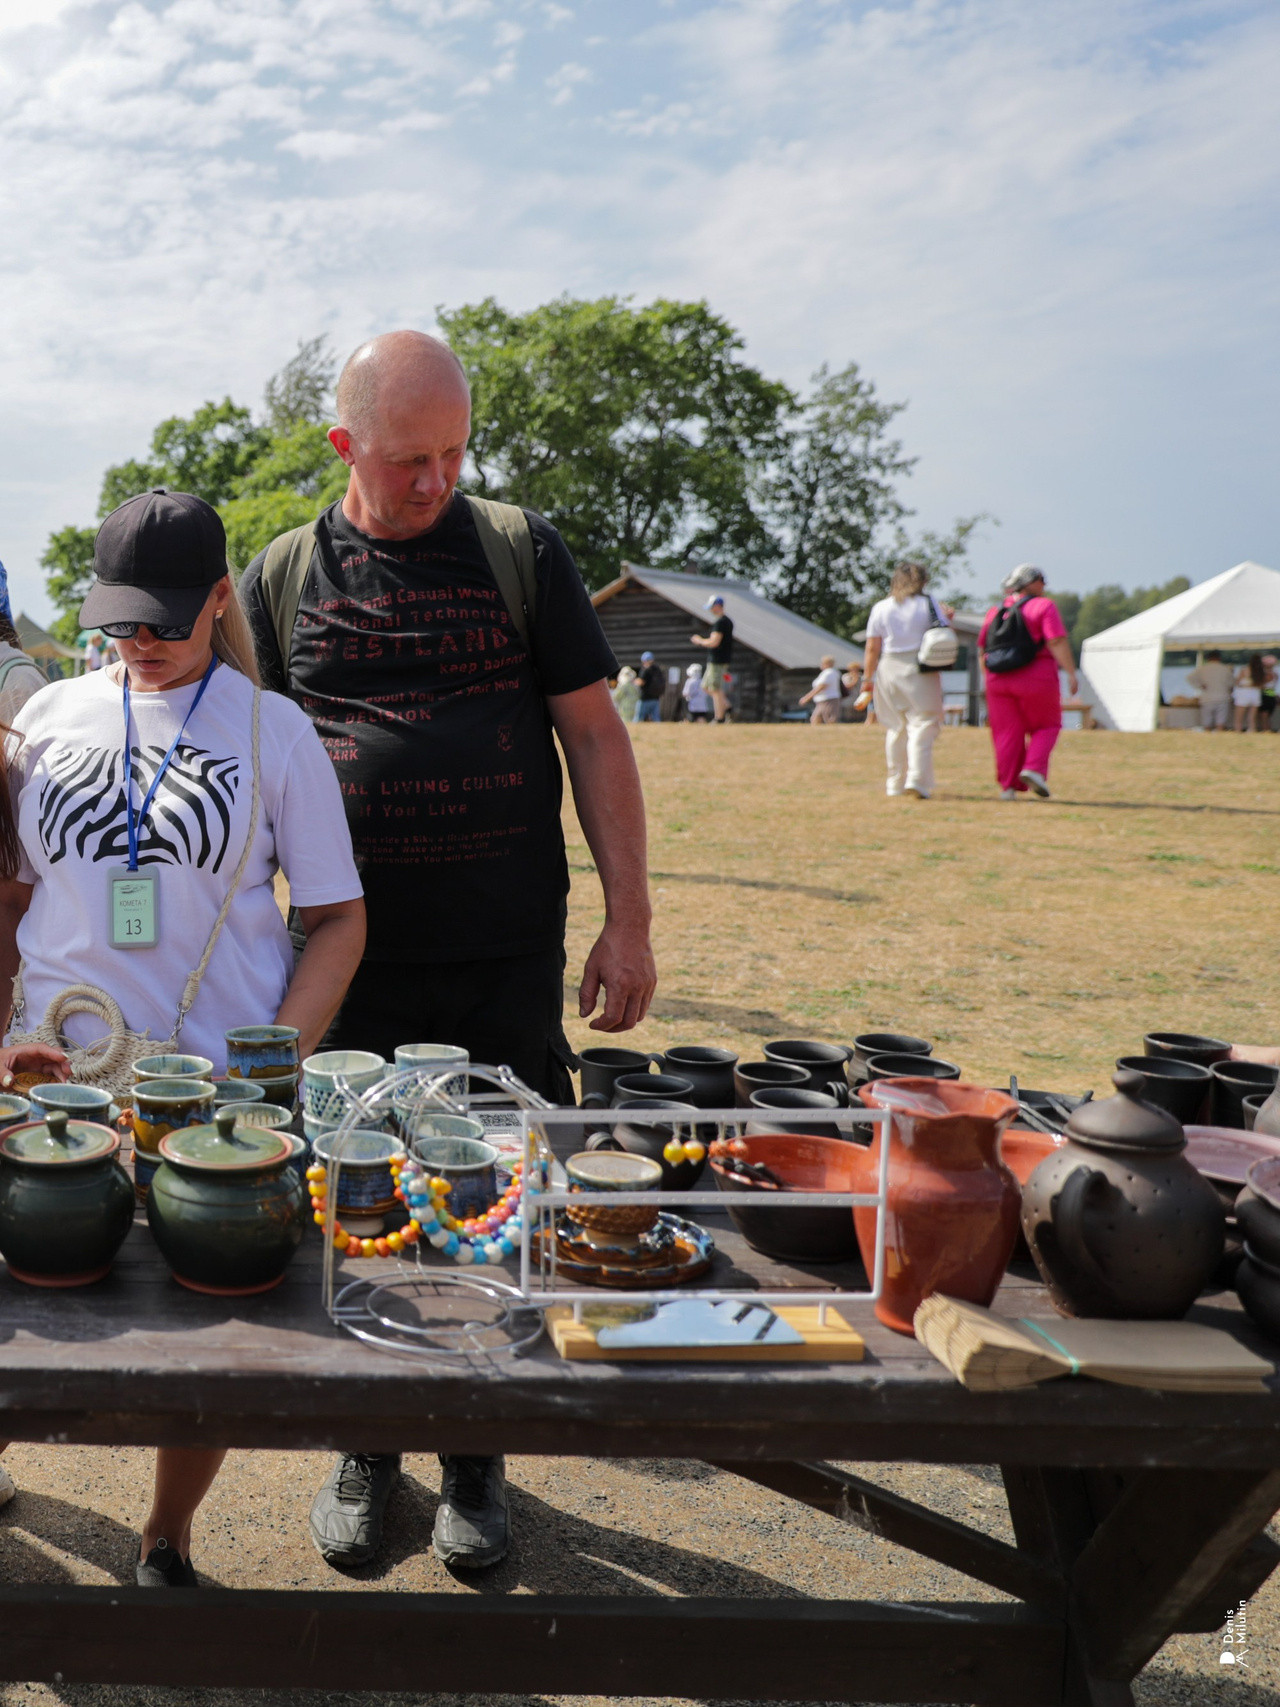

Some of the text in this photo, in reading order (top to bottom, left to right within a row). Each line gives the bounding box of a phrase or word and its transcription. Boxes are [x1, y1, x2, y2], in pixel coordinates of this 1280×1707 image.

[361, 591, 393, 611] and
[397, 585, 453, 604] Casual
[457, 587, 498, 600] Wear
[309, 626, 509, 662] WESTLAND
[344, 708, 431, 725] DECISION
[381, 779, 450, 796] LIVING
[462, 771, 524, 792] CULTURE
[382, 804, 417, 817] You
[428, 803, 468, 817] Live
[125, 918, 142, 936] 13
